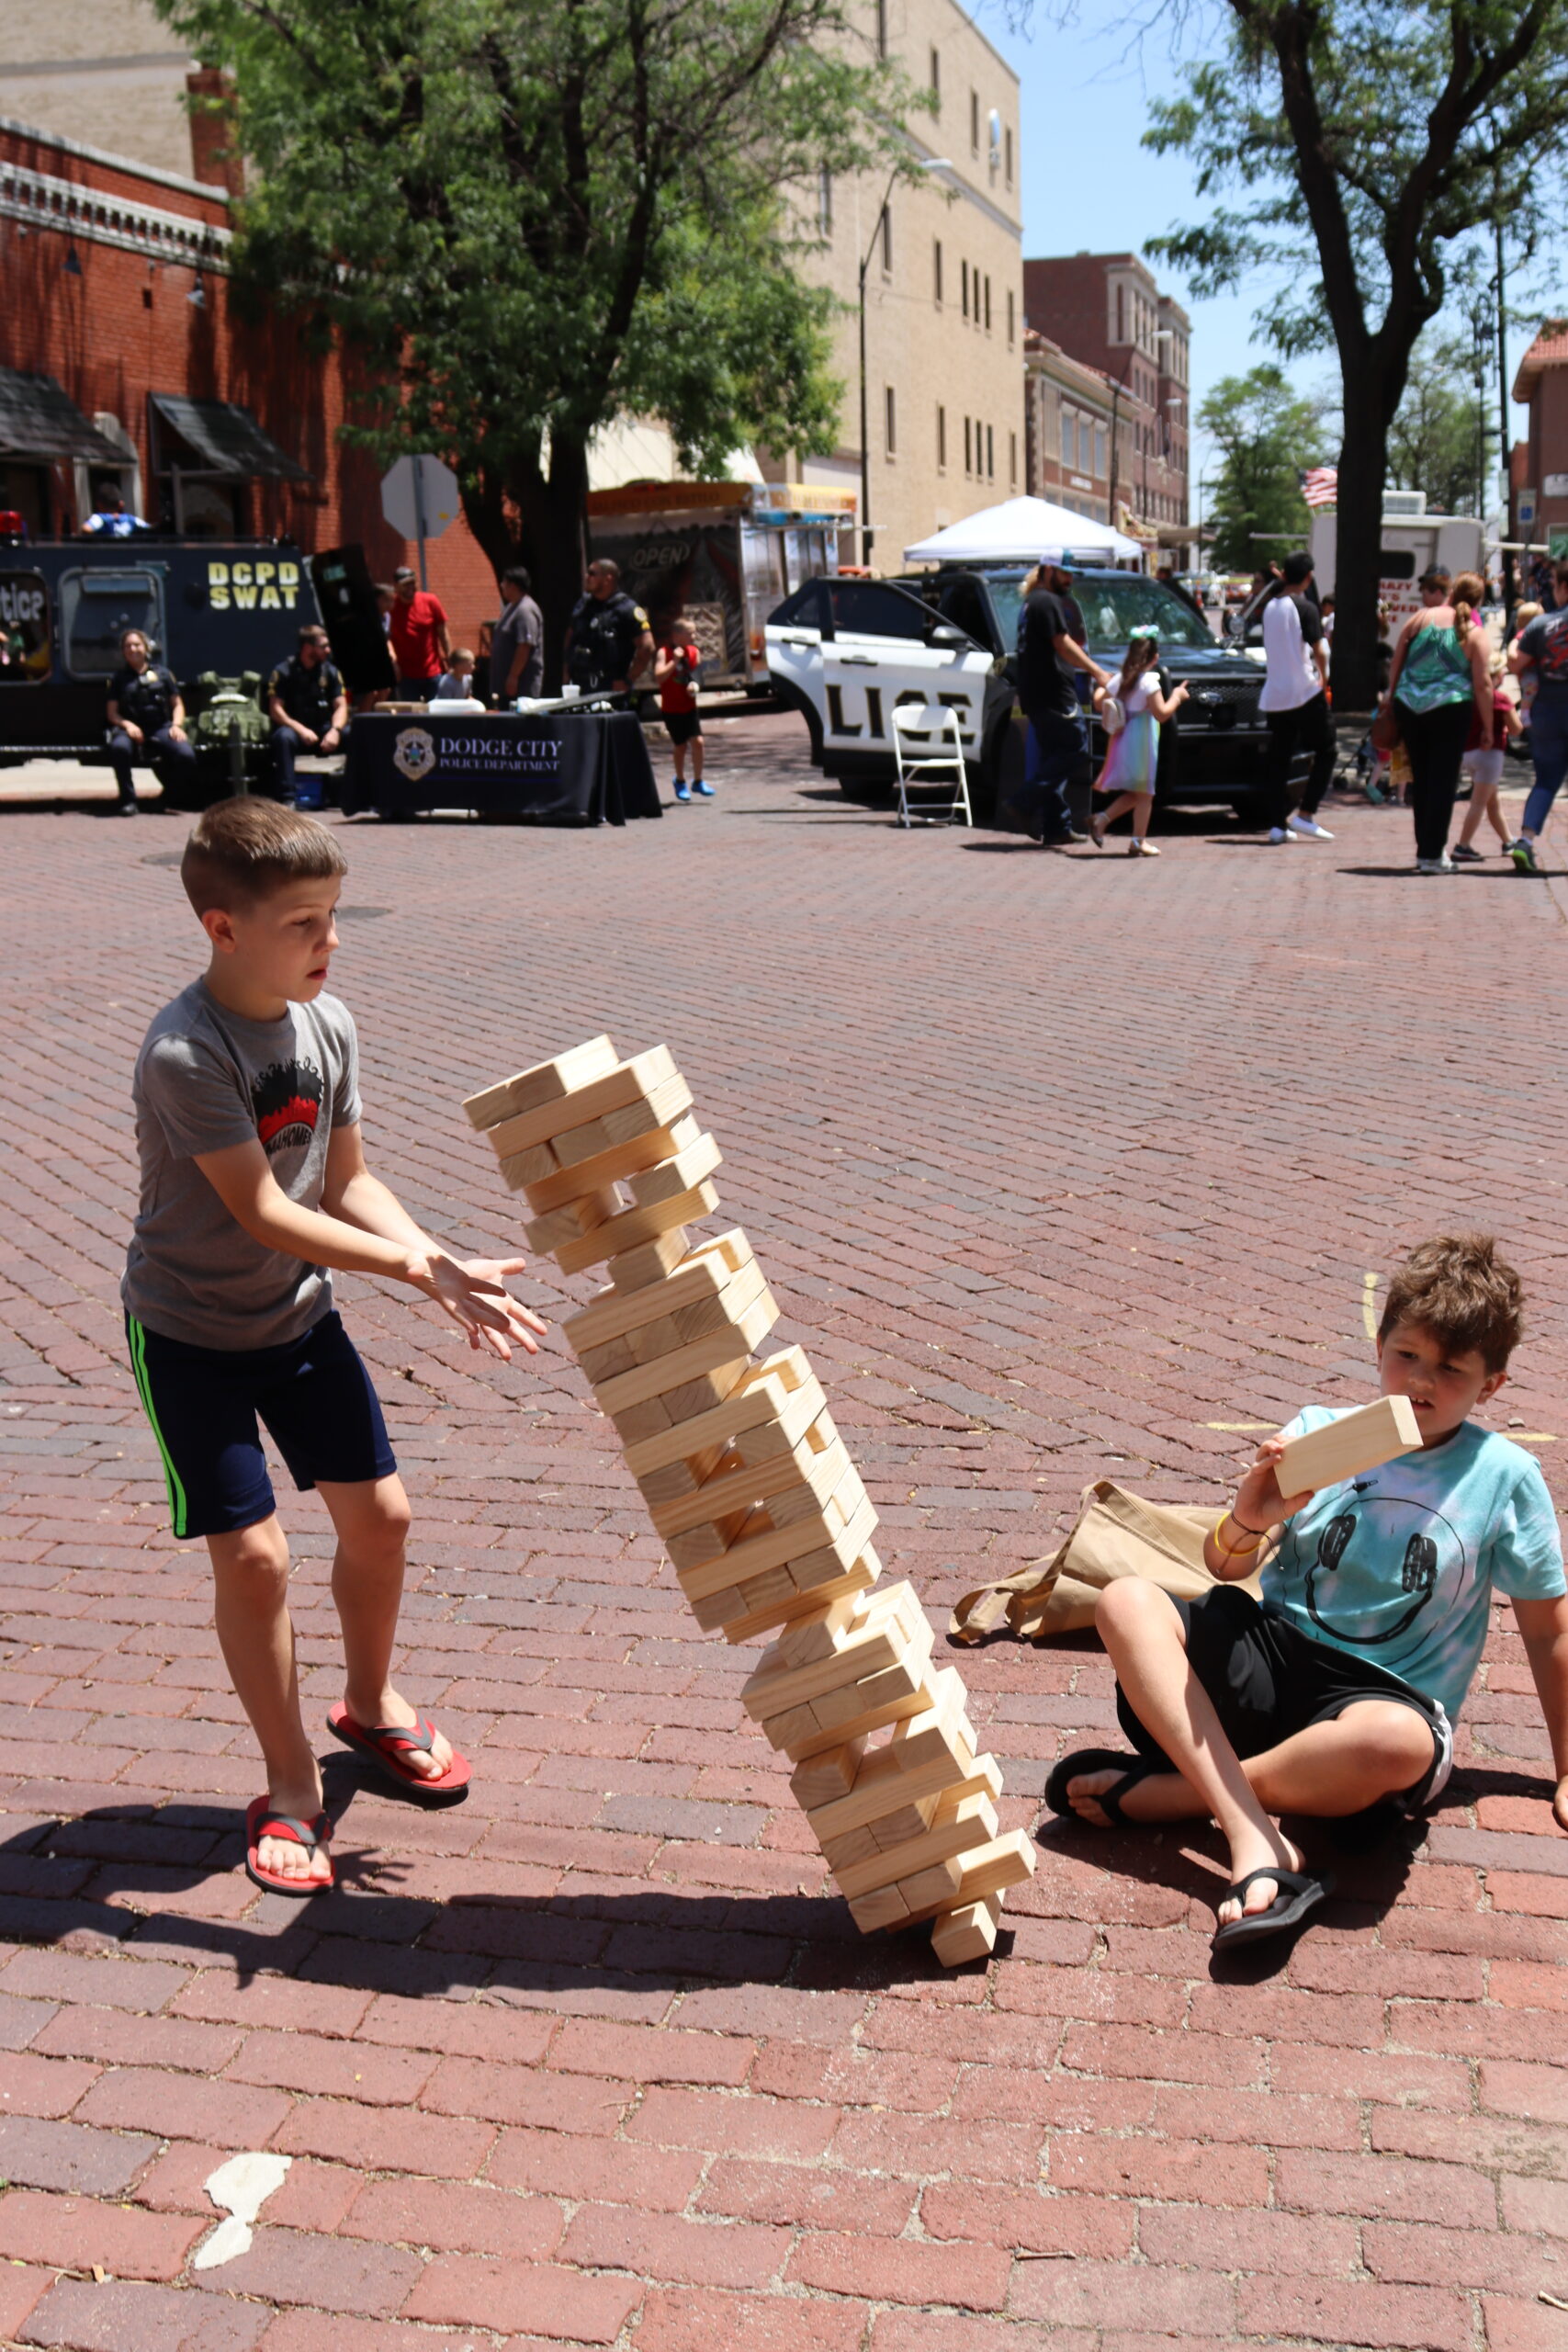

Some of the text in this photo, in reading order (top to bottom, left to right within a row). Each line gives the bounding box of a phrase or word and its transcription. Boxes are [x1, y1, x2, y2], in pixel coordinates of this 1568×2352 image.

[634, 546, 682, 566] OPEN
[208, 561, 299, 585] DCPD
[209, 585, 299, 610] SWAT
[441, 738, 513, 757] DODGE
[516, 740, 562, 758] CITY
[440, 757, 559, 771] POLICE DEPARTMENT
